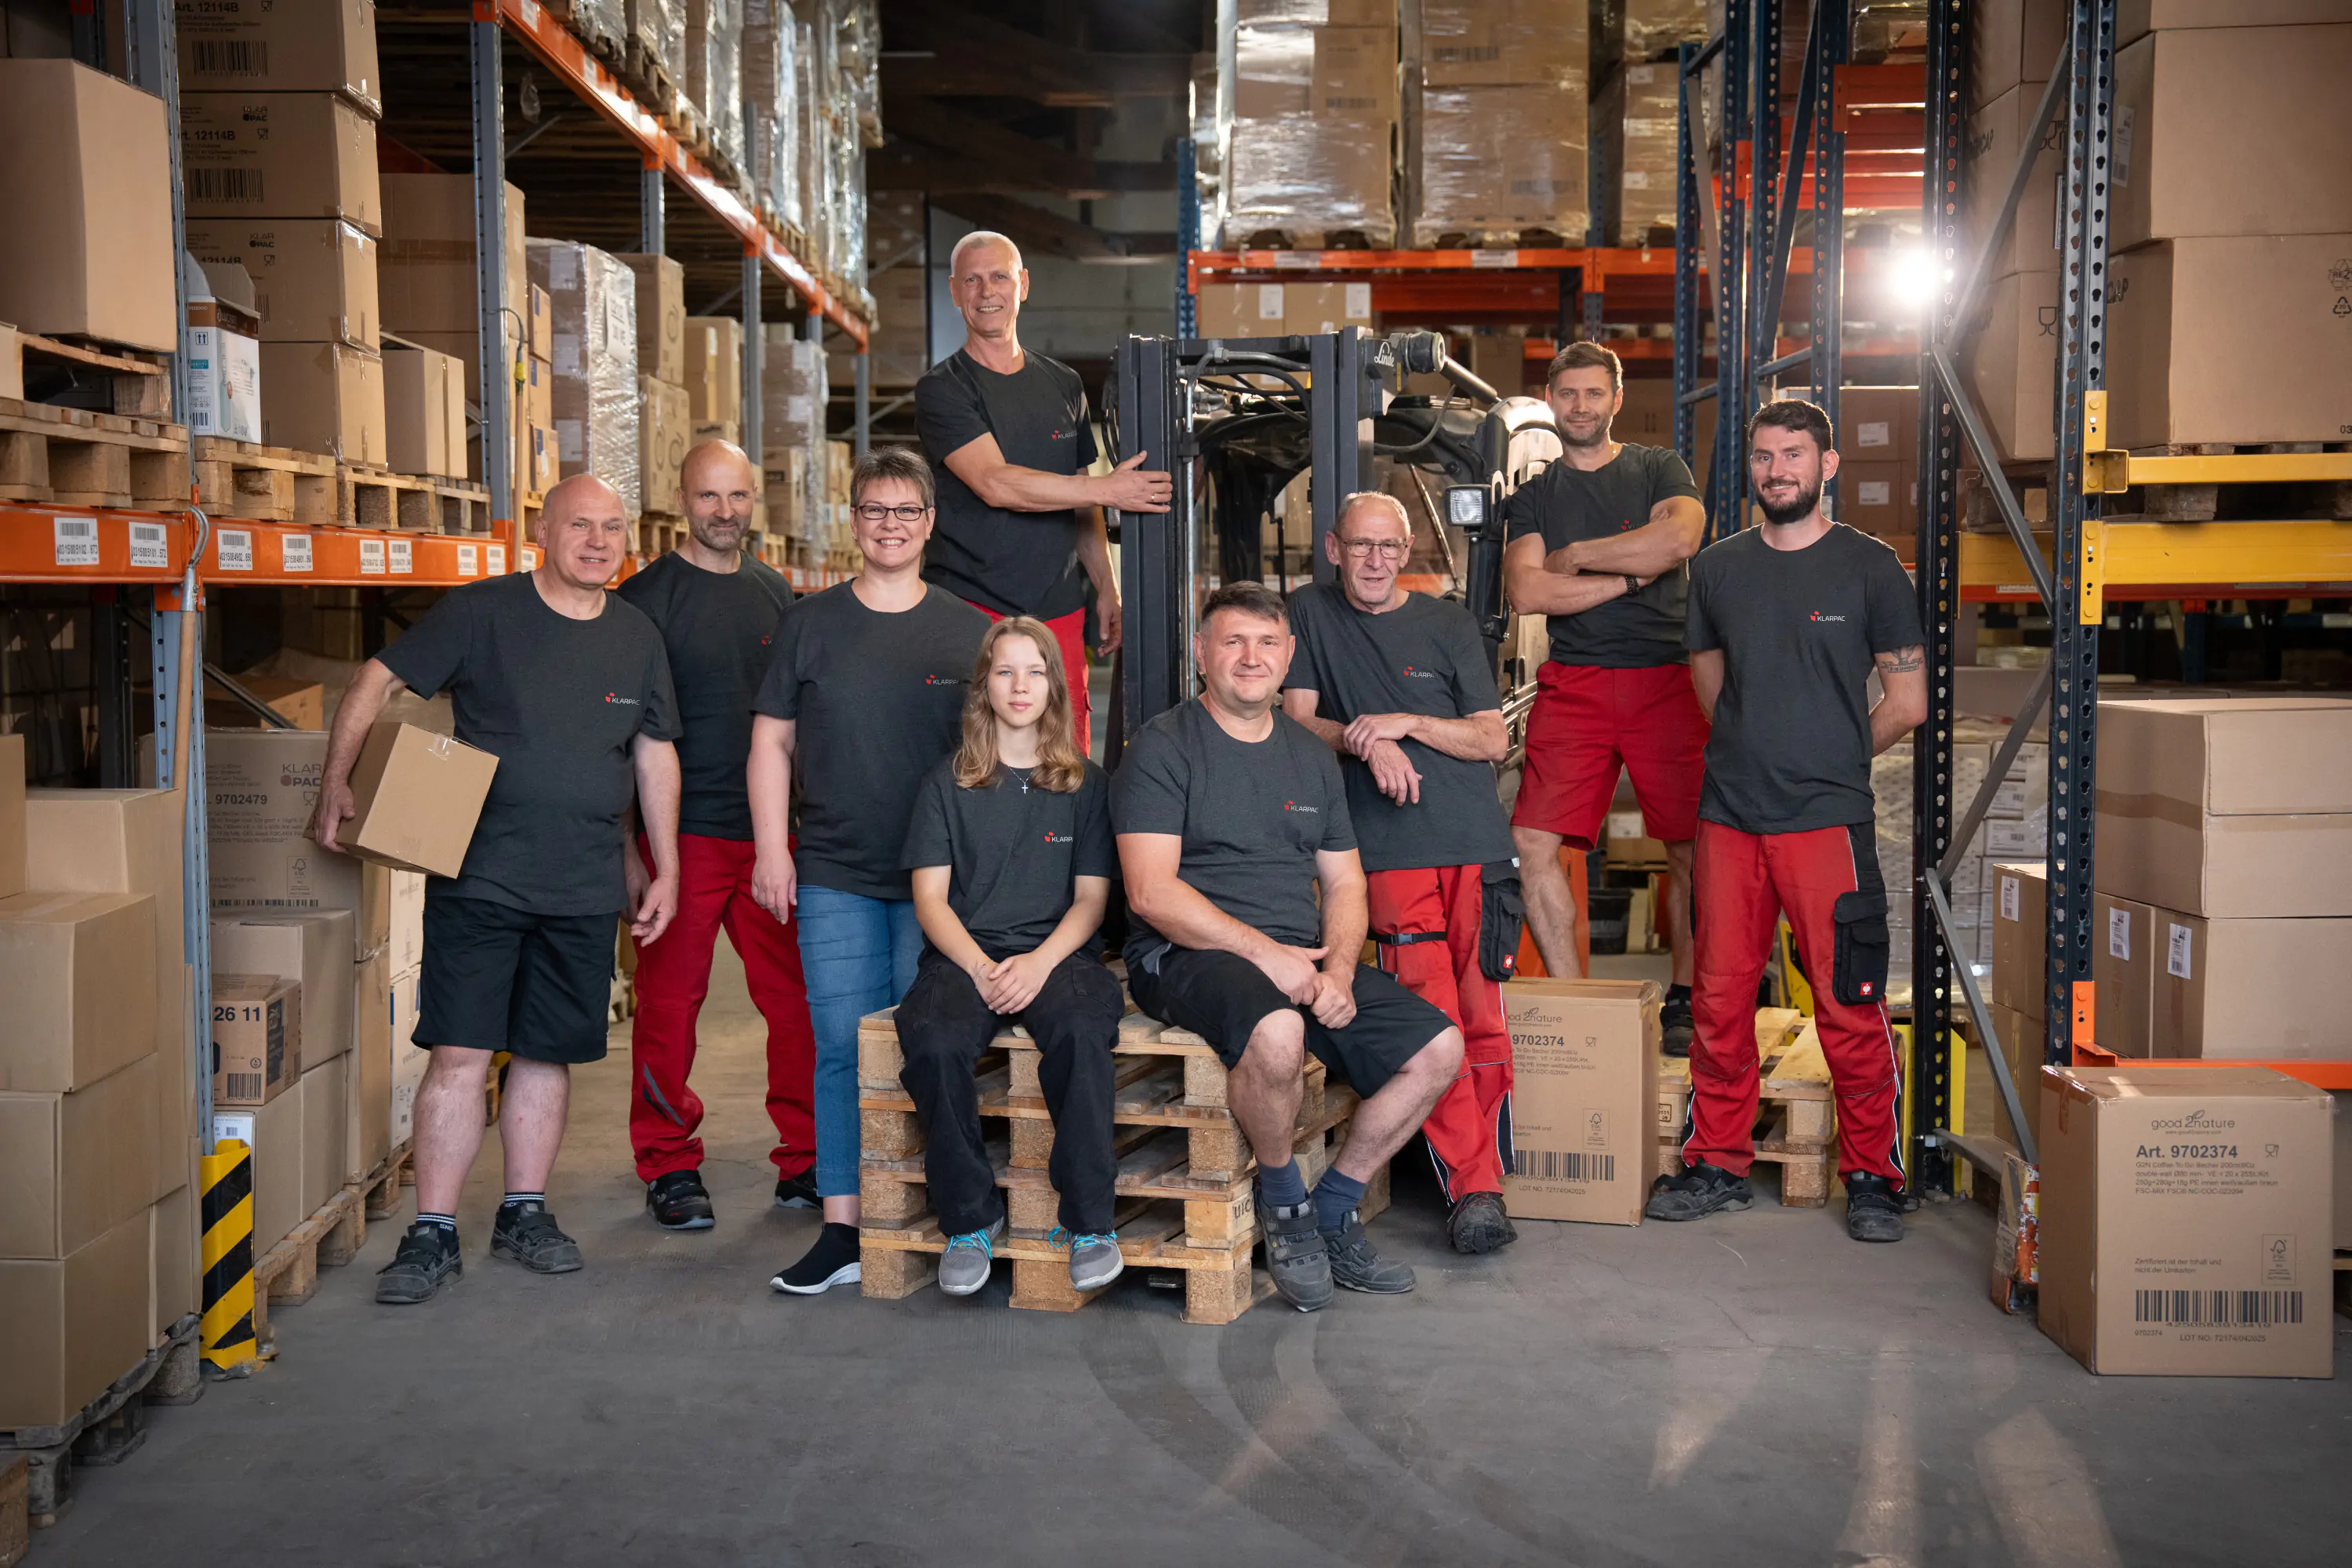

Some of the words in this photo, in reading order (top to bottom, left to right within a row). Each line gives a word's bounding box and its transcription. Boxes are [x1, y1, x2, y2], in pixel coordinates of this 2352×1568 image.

[175, 2, 194, 13] Art.
[198, 2, 239, 13] 12114B
[180, 131, 191, 141] rt.
[195, 130, 235, 140] 12114B
[2333, 270, 2352, 279] REZ
[1374, 341, 1395, 367] Linde
[612, 697, 641, 706] KLARPAC
[283, 764, 321, 774] KLAR
[216, 794, 268, 804] 9702479
[214, 1007, 235, 1022] 26
[242, 1007, 260, 1022] 11
[1507, 1012, 1521, 1022] ood
[1512, 1034, 1565, 1047] 9702374
[2136, 1145, 2165, 1158] Art.
[2171, 1145, 2238, 1158] 9702374
